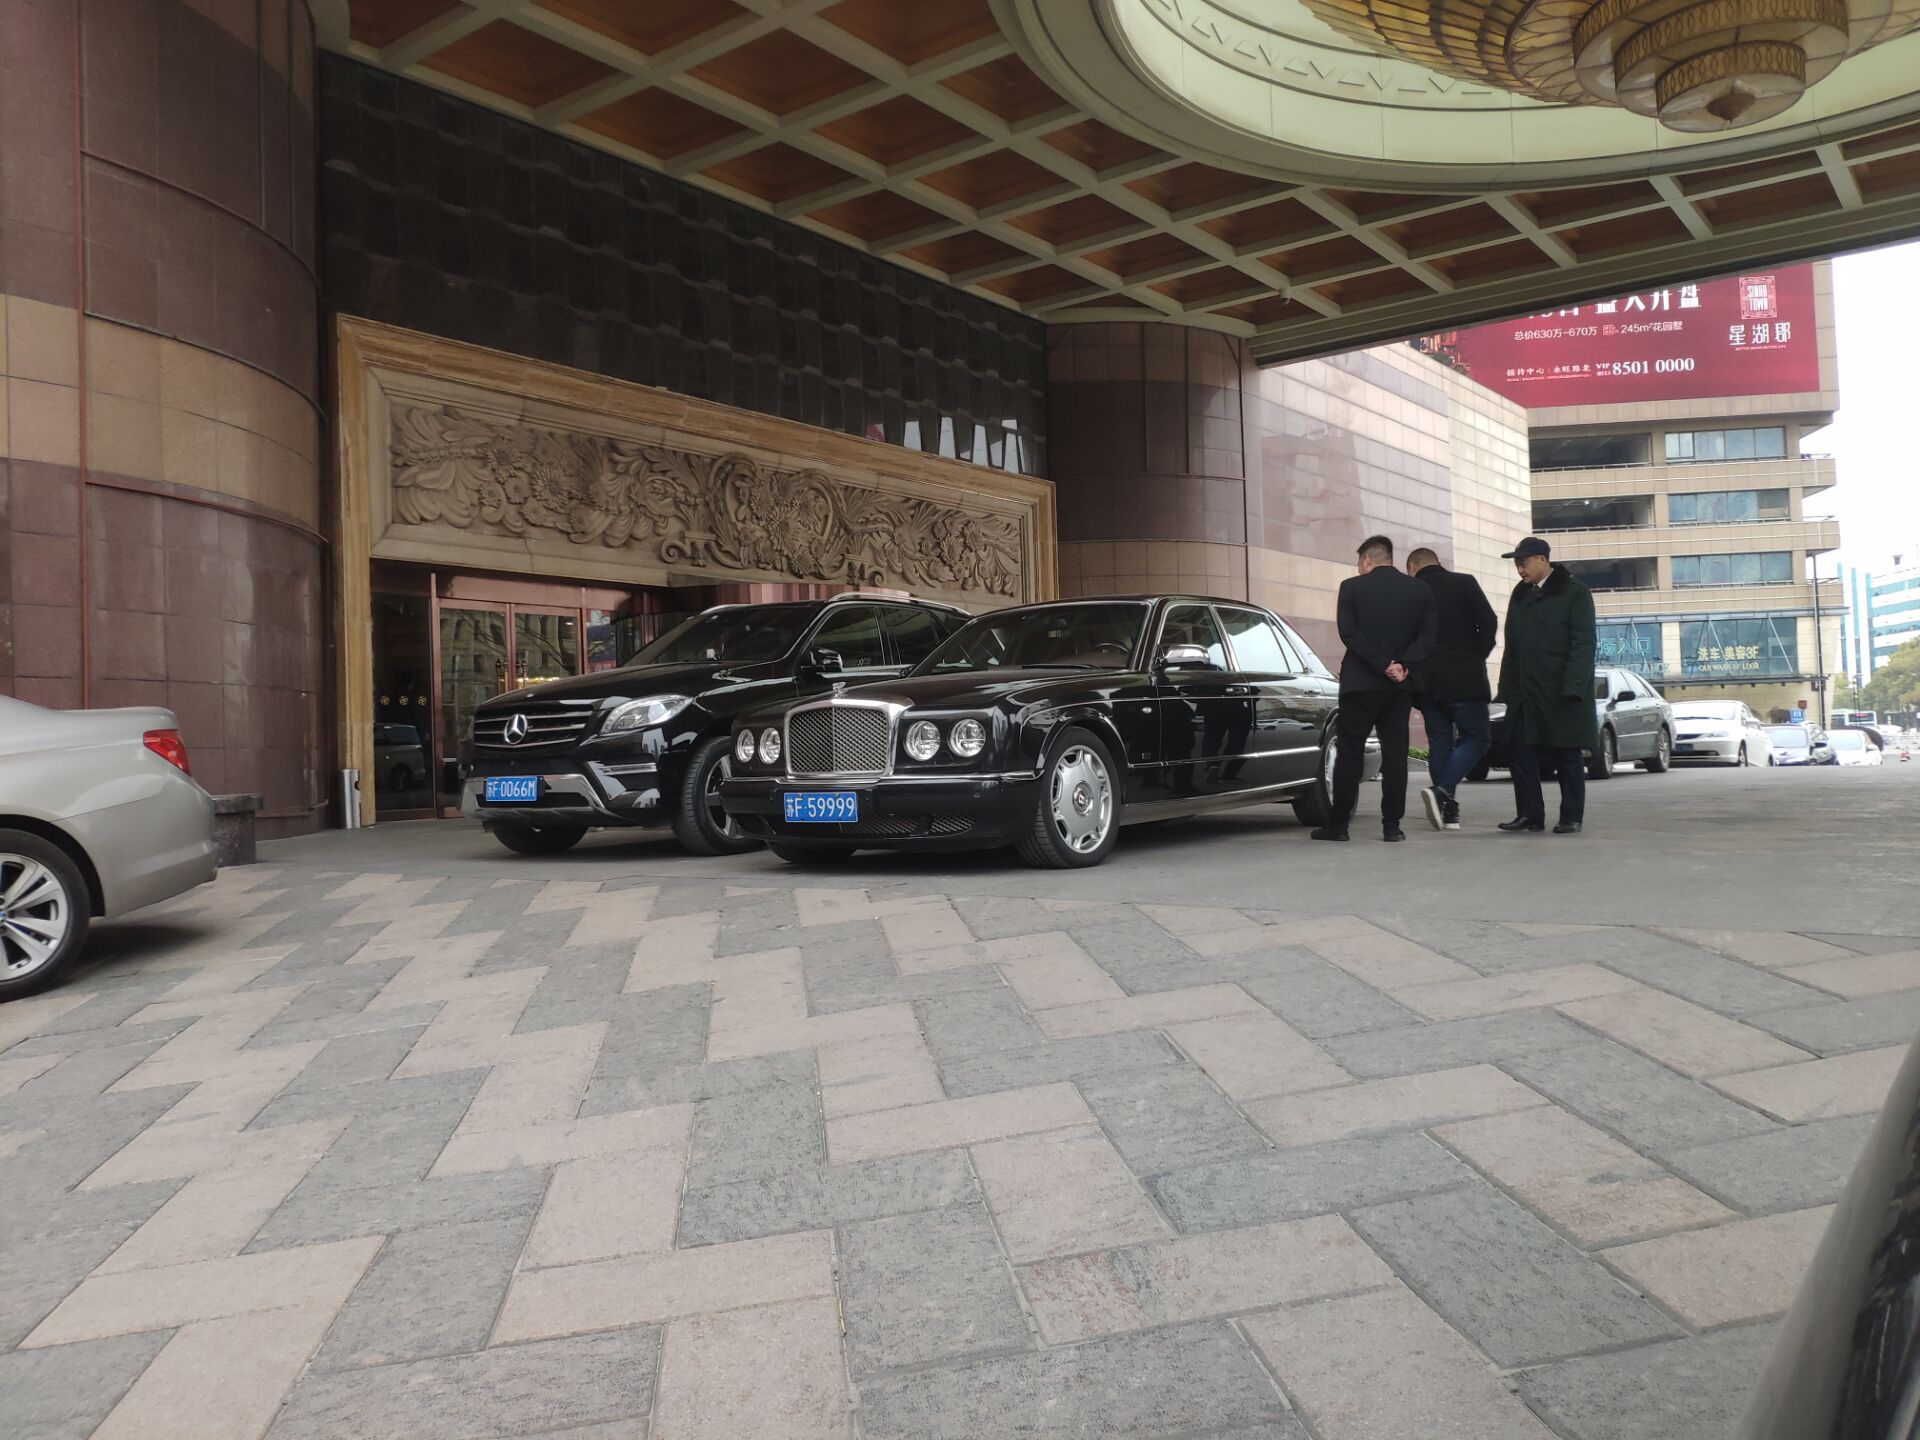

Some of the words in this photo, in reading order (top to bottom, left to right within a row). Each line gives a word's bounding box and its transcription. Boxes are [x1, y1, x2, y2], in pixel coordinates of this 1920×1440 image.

[1729, 322, 1791, 346] 星湖郡
[1507, 367, 1545, 377] 接待中心
[1612, 360, 1649, 376] 8501
[1655, 358, 1695, 374] 0000
